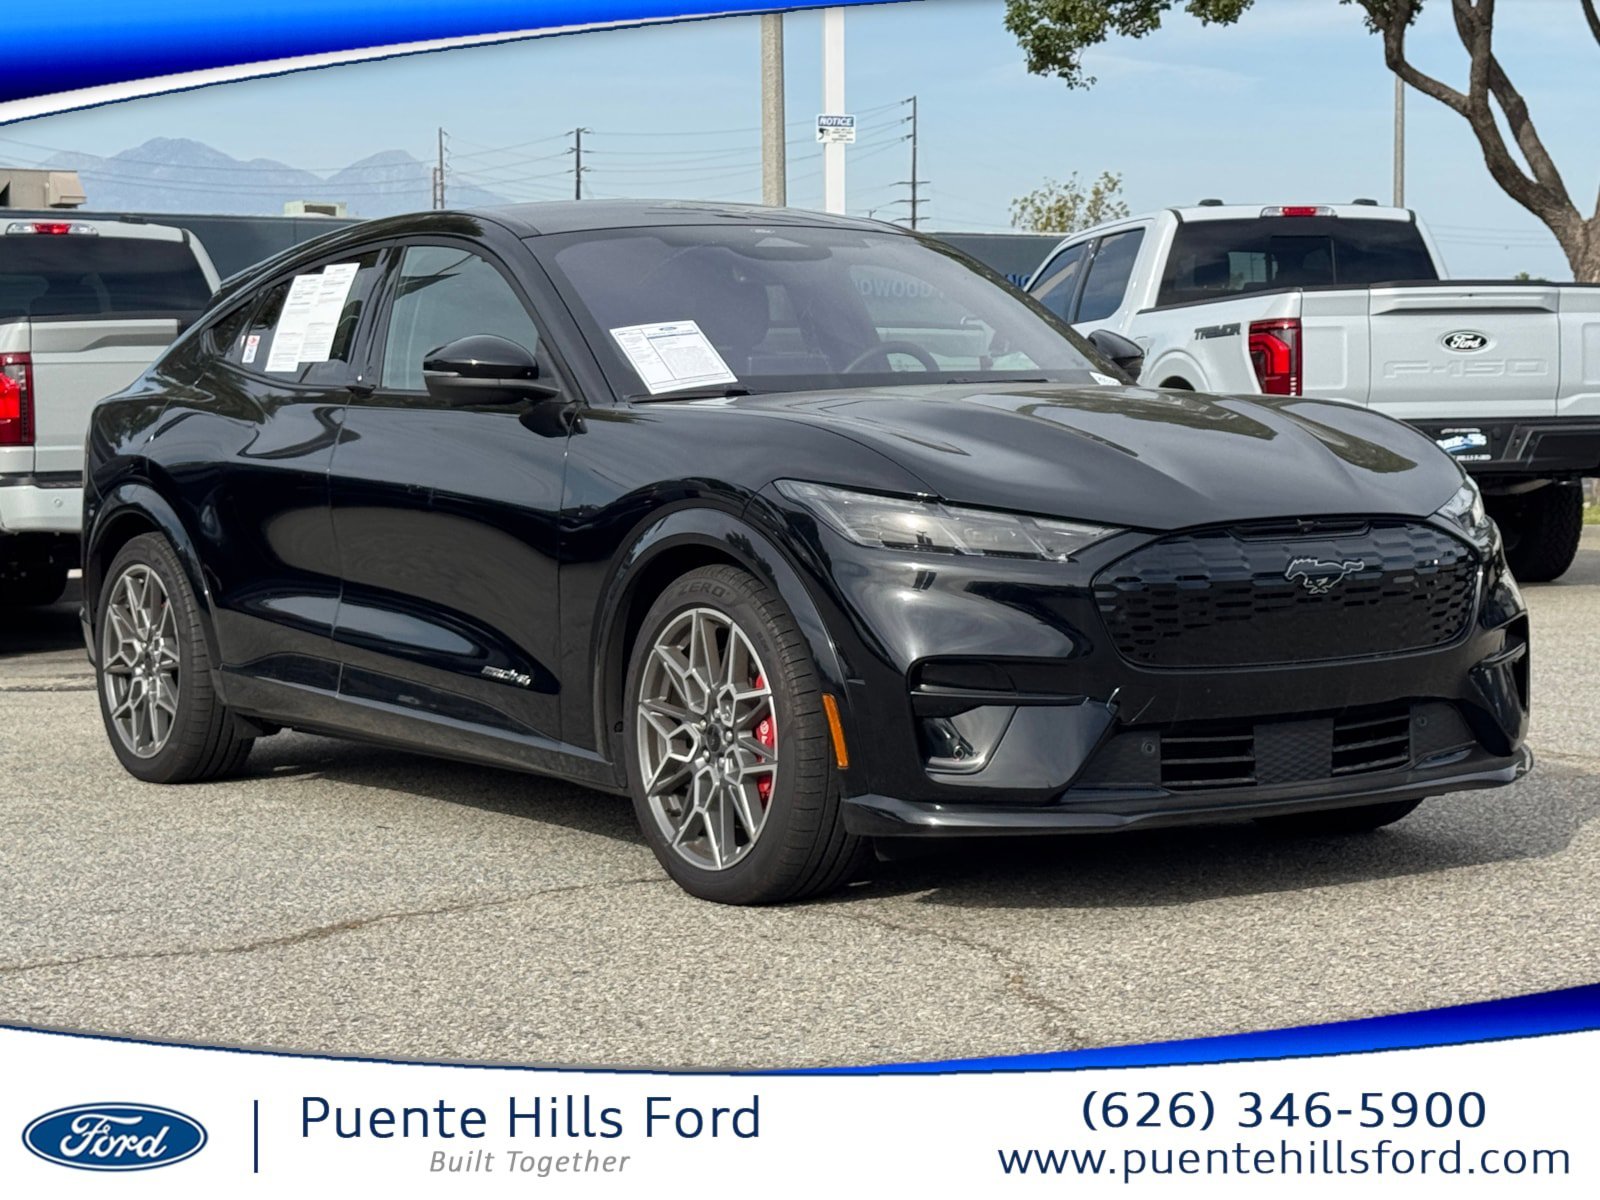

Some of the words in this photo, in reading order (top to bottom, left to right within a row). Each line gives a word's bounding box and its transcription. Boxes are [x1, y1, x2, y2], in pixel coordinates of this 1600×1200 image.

[819, 117, 853, 126] NOTICE
[1449, 334, 1482, 348] Ford
[1384, 358, 1548, 378] F-150
[678, 581, 726, 598] ZERO
